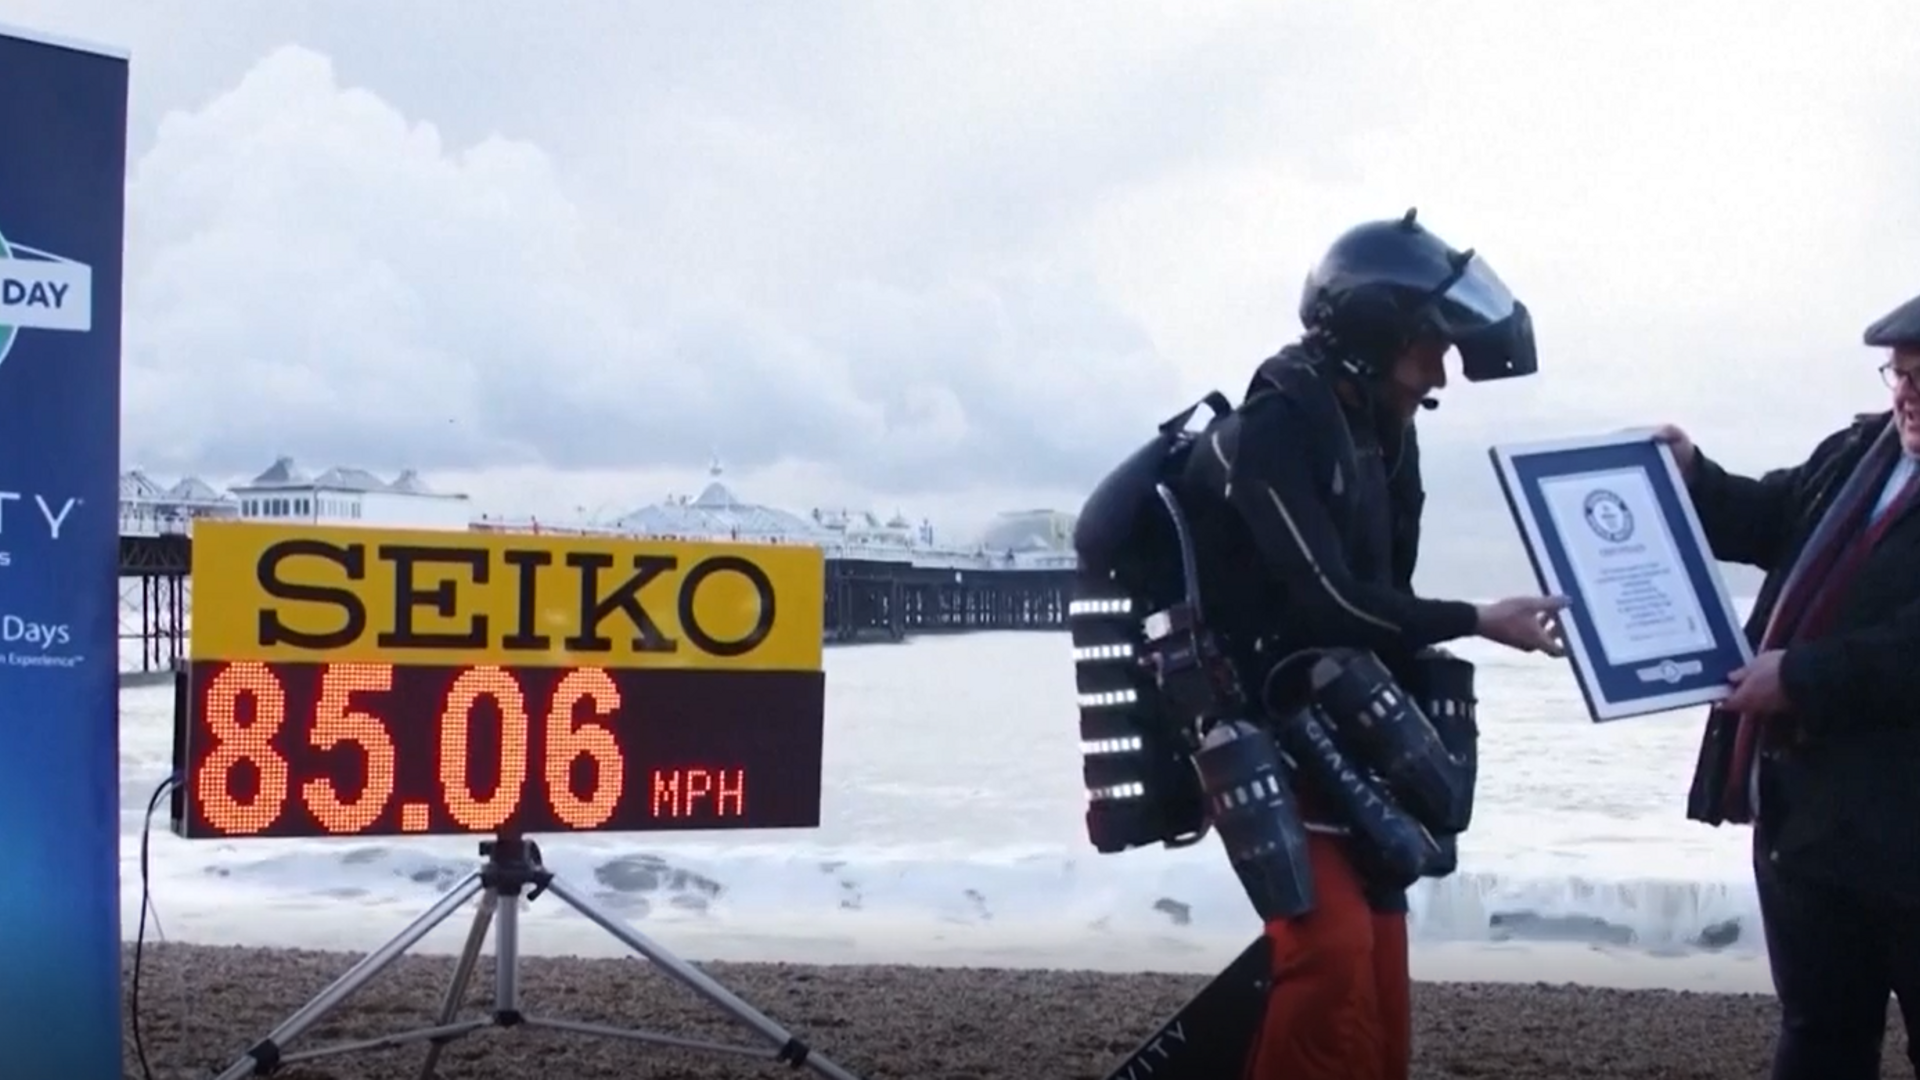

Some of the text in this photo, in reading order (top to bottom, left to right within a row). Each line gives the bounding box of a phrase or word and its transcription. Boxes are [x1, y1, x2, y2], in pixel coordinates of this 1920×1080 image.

[2, 278, 69, 309] DAY
[3, 614, 70, 649] Days
[257, 540, 776, 656] SEIKO
[198, 661, 744, 834] 85.06 MPH
